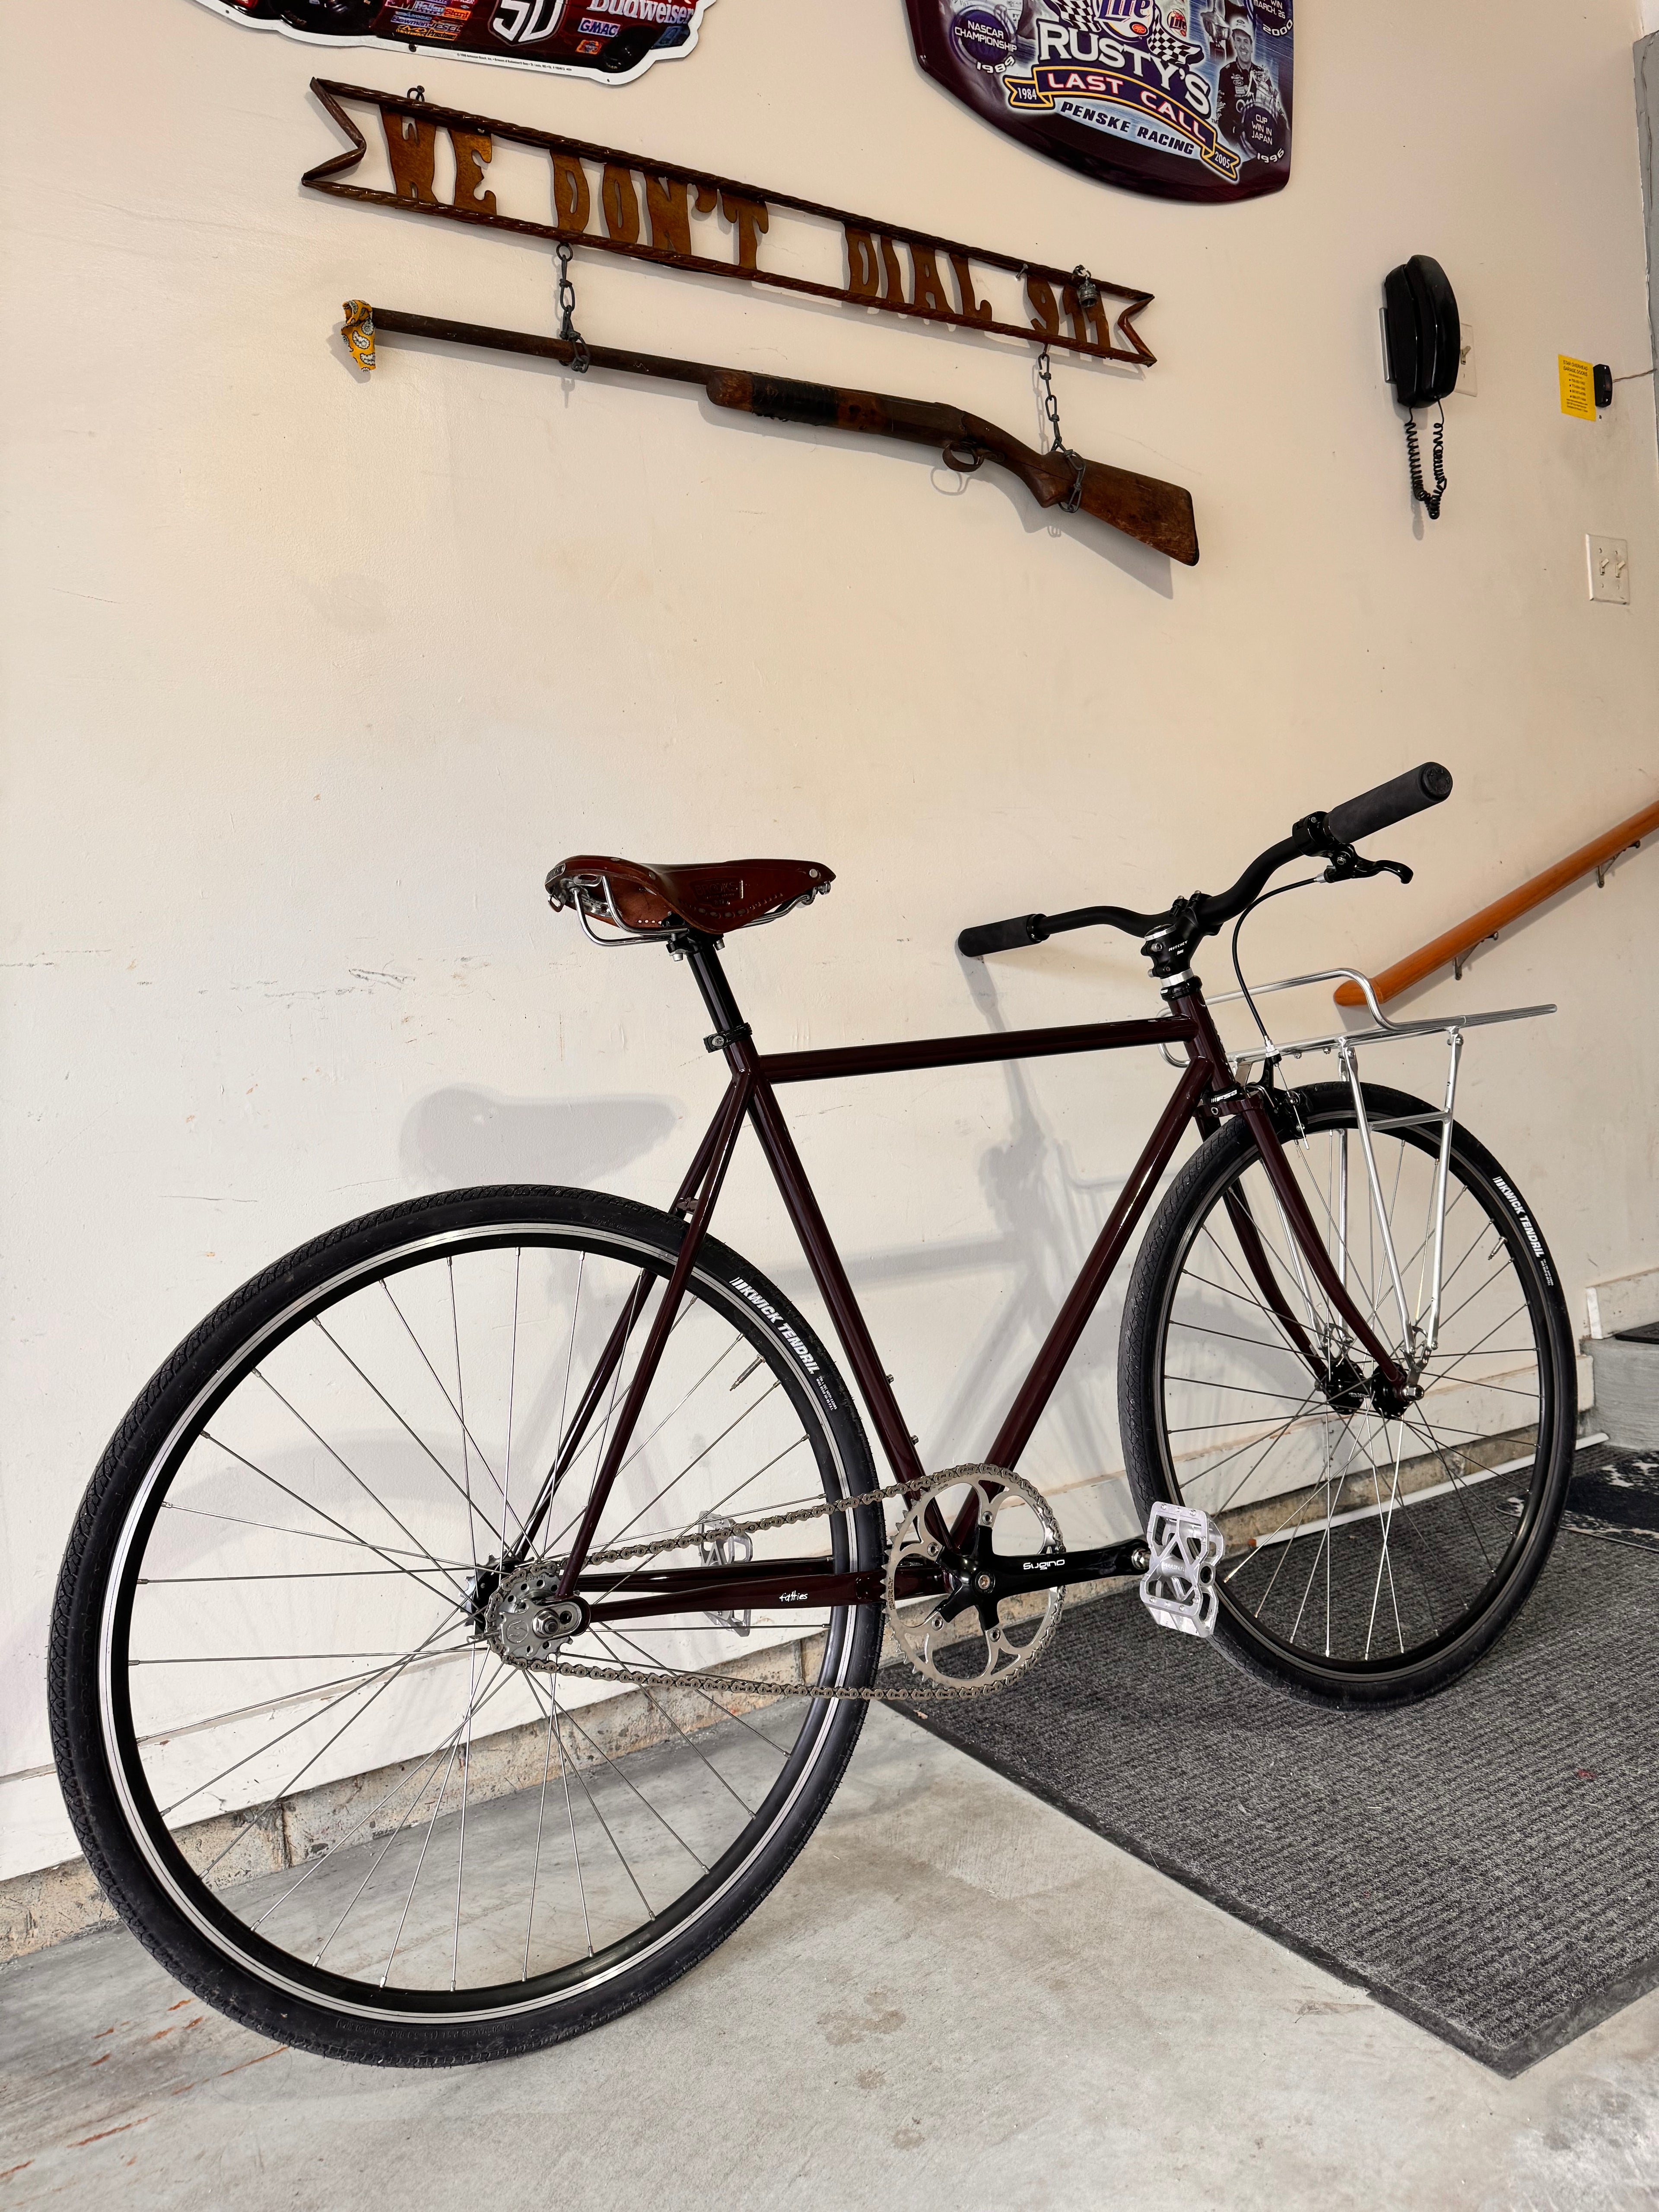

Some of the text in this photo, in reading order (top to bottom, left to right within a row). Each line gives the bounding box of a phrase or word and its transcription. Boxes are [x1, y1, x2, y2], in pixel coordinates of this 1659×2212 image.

[1271, 0, 1282, 9] WIN
[445, 8, 468, 18] Stant
[1278, 10, 1286, 19] 26
[392, 16, 428, 27] Bowman
[429, 22, 461, 32] JESEL
[581, 20, 619, 36] GMAC
[1263, 19, 1293, 36] 2000
[968, 20, 1004, 39] NASCAR
[955, 26, 1017, 52] CHAMPIONSHIP
[976, 56, 1015, 73] 1989
[1038, 20, 1209, 115] RUSTY'S
[1017, 87, 1036, 100] 1984
[1047, 73, 1123, 94] LAST
[1140, 90, 1206, 143] CALL
[1256, 114, 1268, 124] CUP
[1061, 101, 1195, 155] PENSKE RACING
[1252, 121, 1272, 136] WIN IN
[1252, 130, 1272, 145] JAPAN
[1214, 151, 1230, 168] 2005
[1257, 148, 1284, 163] 1996
[380, 103, 1111, 348] WE DON'T DIAL 911
[695, 882, 737, 895] BROOKS
[1169, 940, 1188, 952] RITCHEY
[1498, 1184, 1545, 1258] KWICK TENDRIL
[739, 1285, 820, 1374] KWICK TENDRIL
[1023, 1559, 1065, 1570] Sugino
[779, 1590, 808, 1602] fatties
